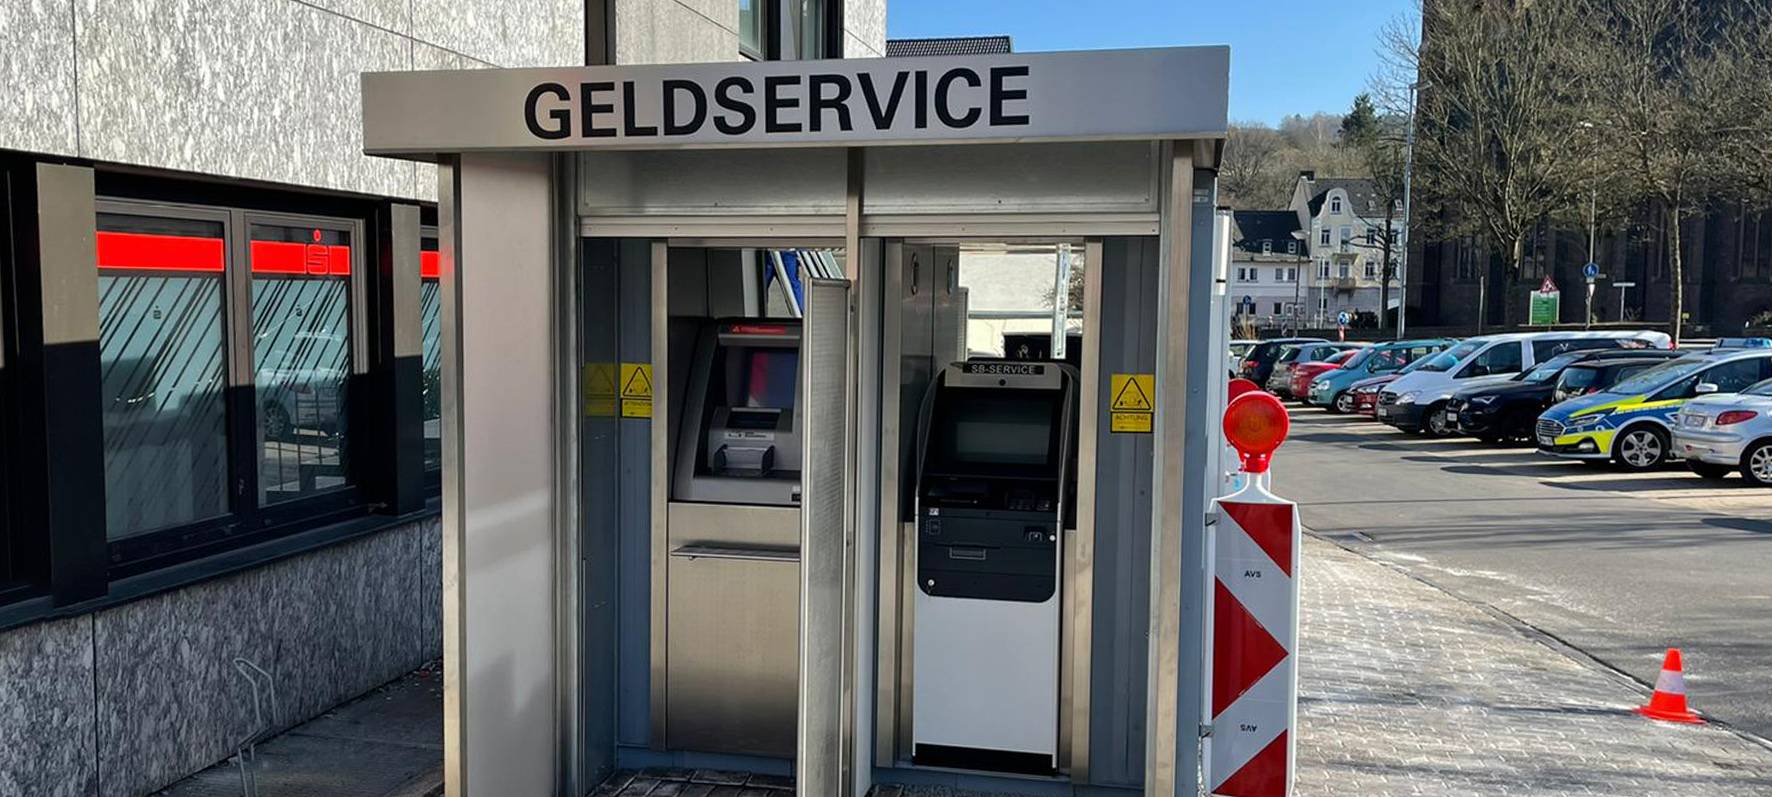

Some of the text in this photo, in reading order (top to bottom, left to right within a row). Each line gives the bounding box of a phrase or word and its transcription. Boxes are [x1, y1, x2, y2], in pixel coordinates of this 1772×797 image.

[524, 65, 1030, 140] GELDSERVICE
[971, 364, 1034, 374] SB-SERVICE
[1244, 570, 1262, 578] AVS
[1240, 724, 1257, 733] AVS
